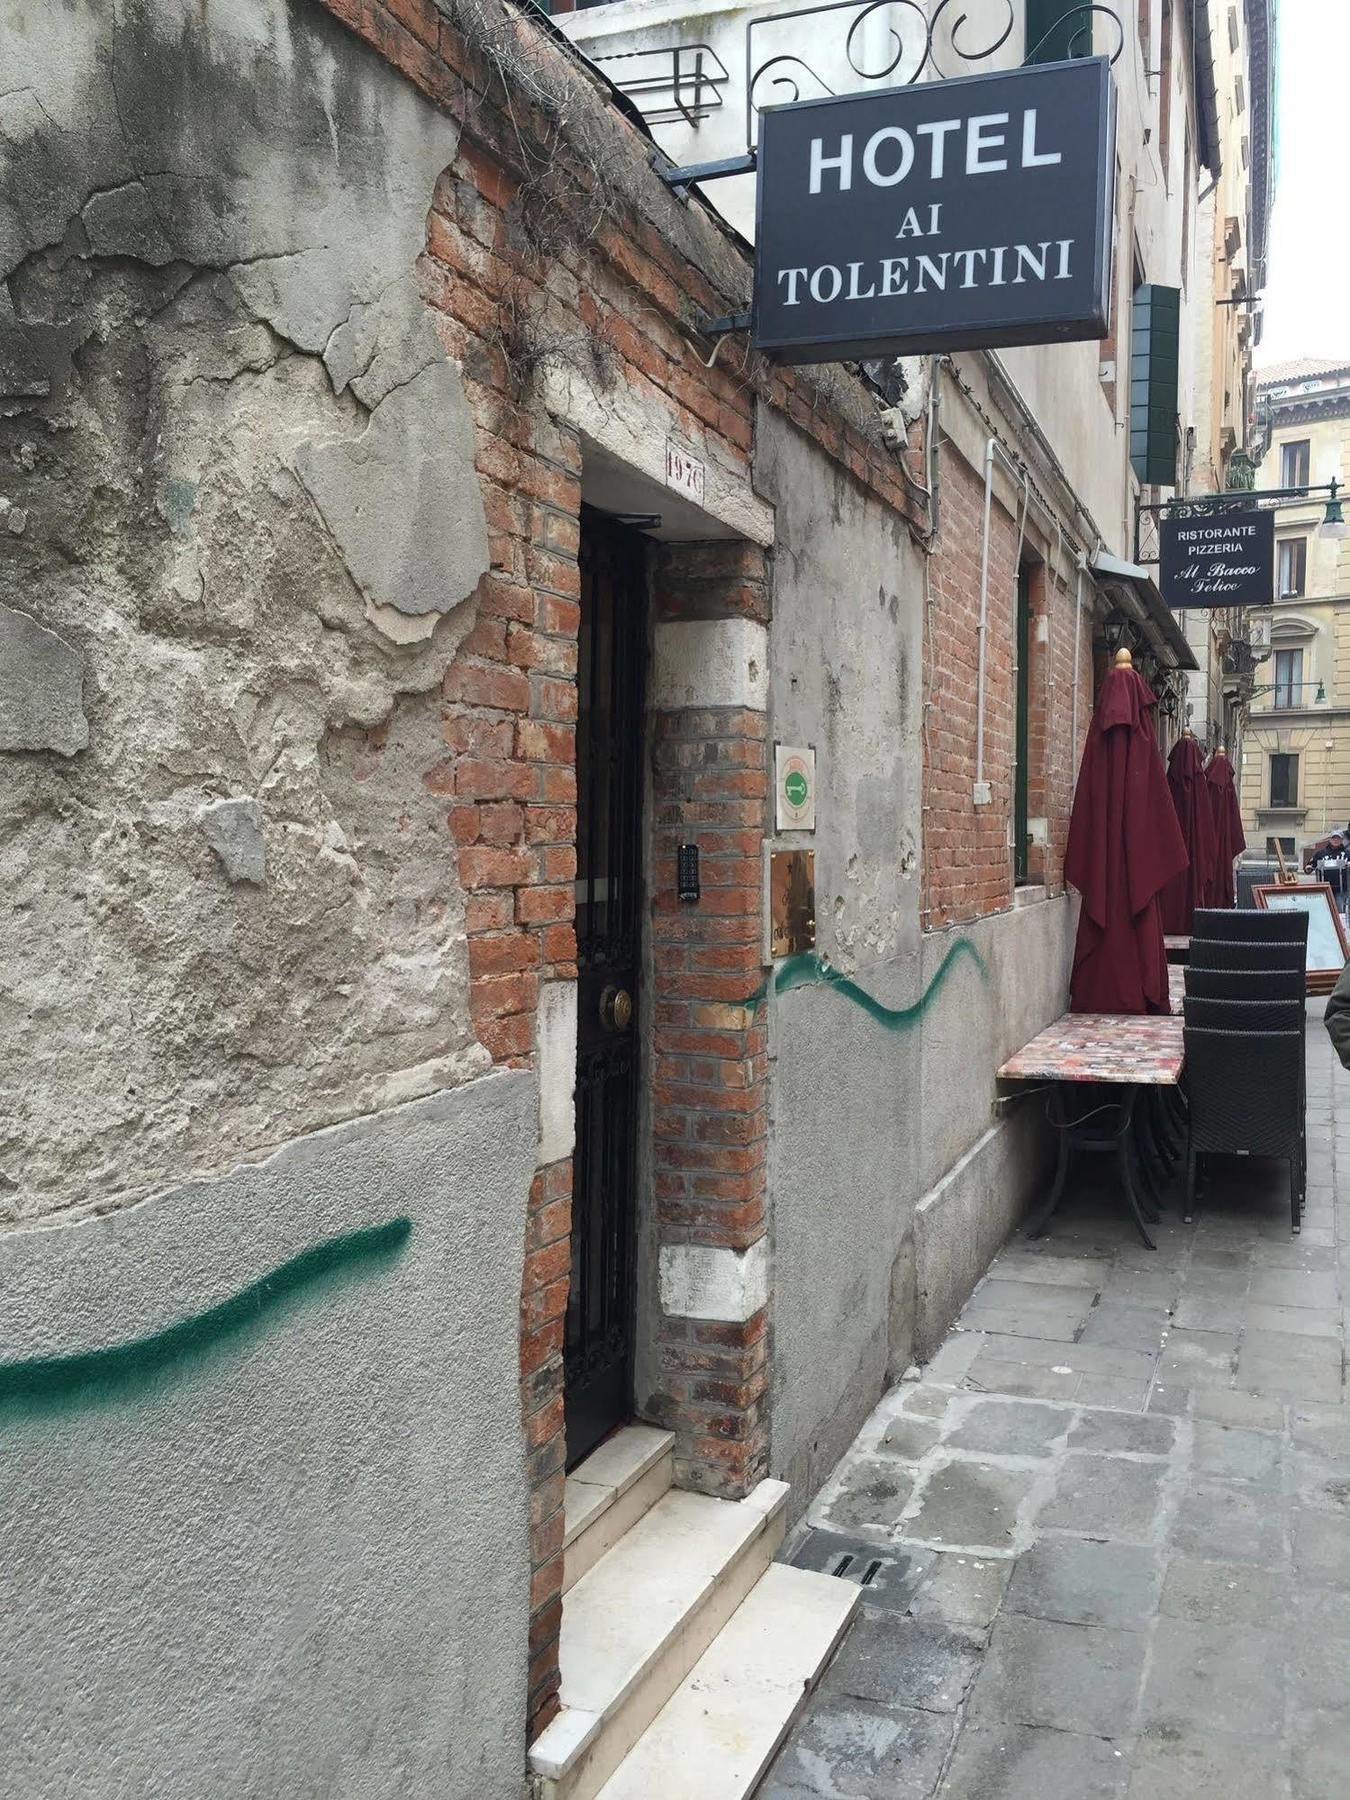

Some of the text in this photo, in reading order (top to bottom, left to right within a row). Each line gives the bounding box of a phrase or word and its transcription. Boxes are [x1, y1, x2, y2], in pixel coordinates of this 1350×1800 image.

[809, 109, 1062, 194] HOTEL
[896, 203, 943, 239] AI
[777, 239, 1075, 306] TOLENTINI
[1178, 526, 1257, 541] RISTORANTE
[1188, 543, 1243, 555] PIZZERIA
[1174, 563, 1261, 579] Al Bacco
[1191, 578, 1242, 593] Felice
